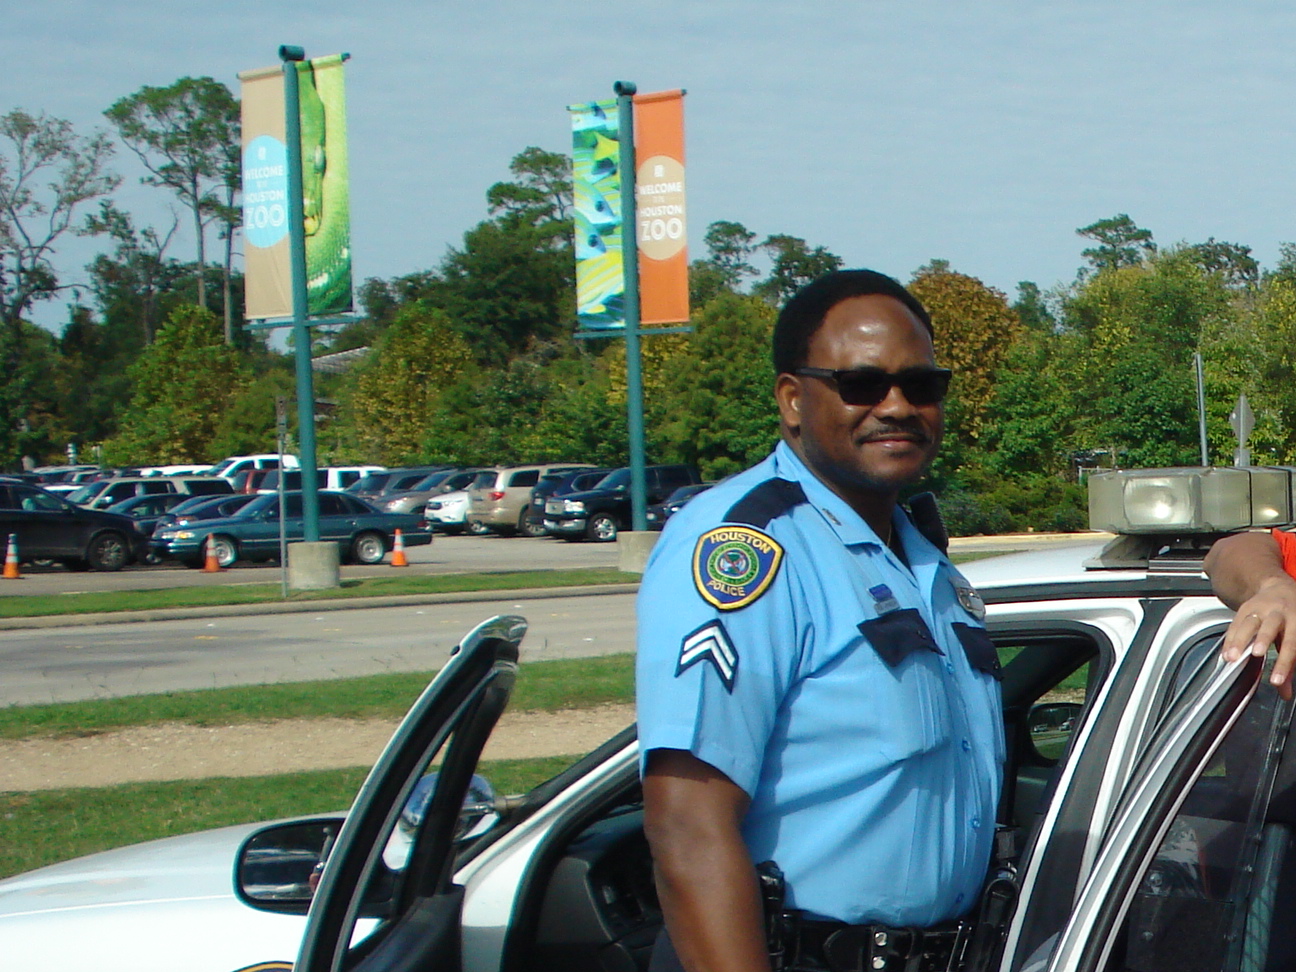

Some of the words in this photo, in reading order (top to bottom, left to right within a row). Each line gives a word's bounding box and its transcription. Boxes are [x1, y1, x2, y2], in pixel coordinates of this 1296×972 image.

[244, 165, 284, 180] WELCOME
[639, 182, 683, 195] WELCOME
[245, 190, 284, 203] HOUSTON
[245, 203, 285, 230] ZOO
[640, 205, 683, 217] HOUSTON
[641, 218, 683, 241] ZOO
[710, 531, 772, 554] HOUSTON
[706, 580, 746, 596] POLICE
